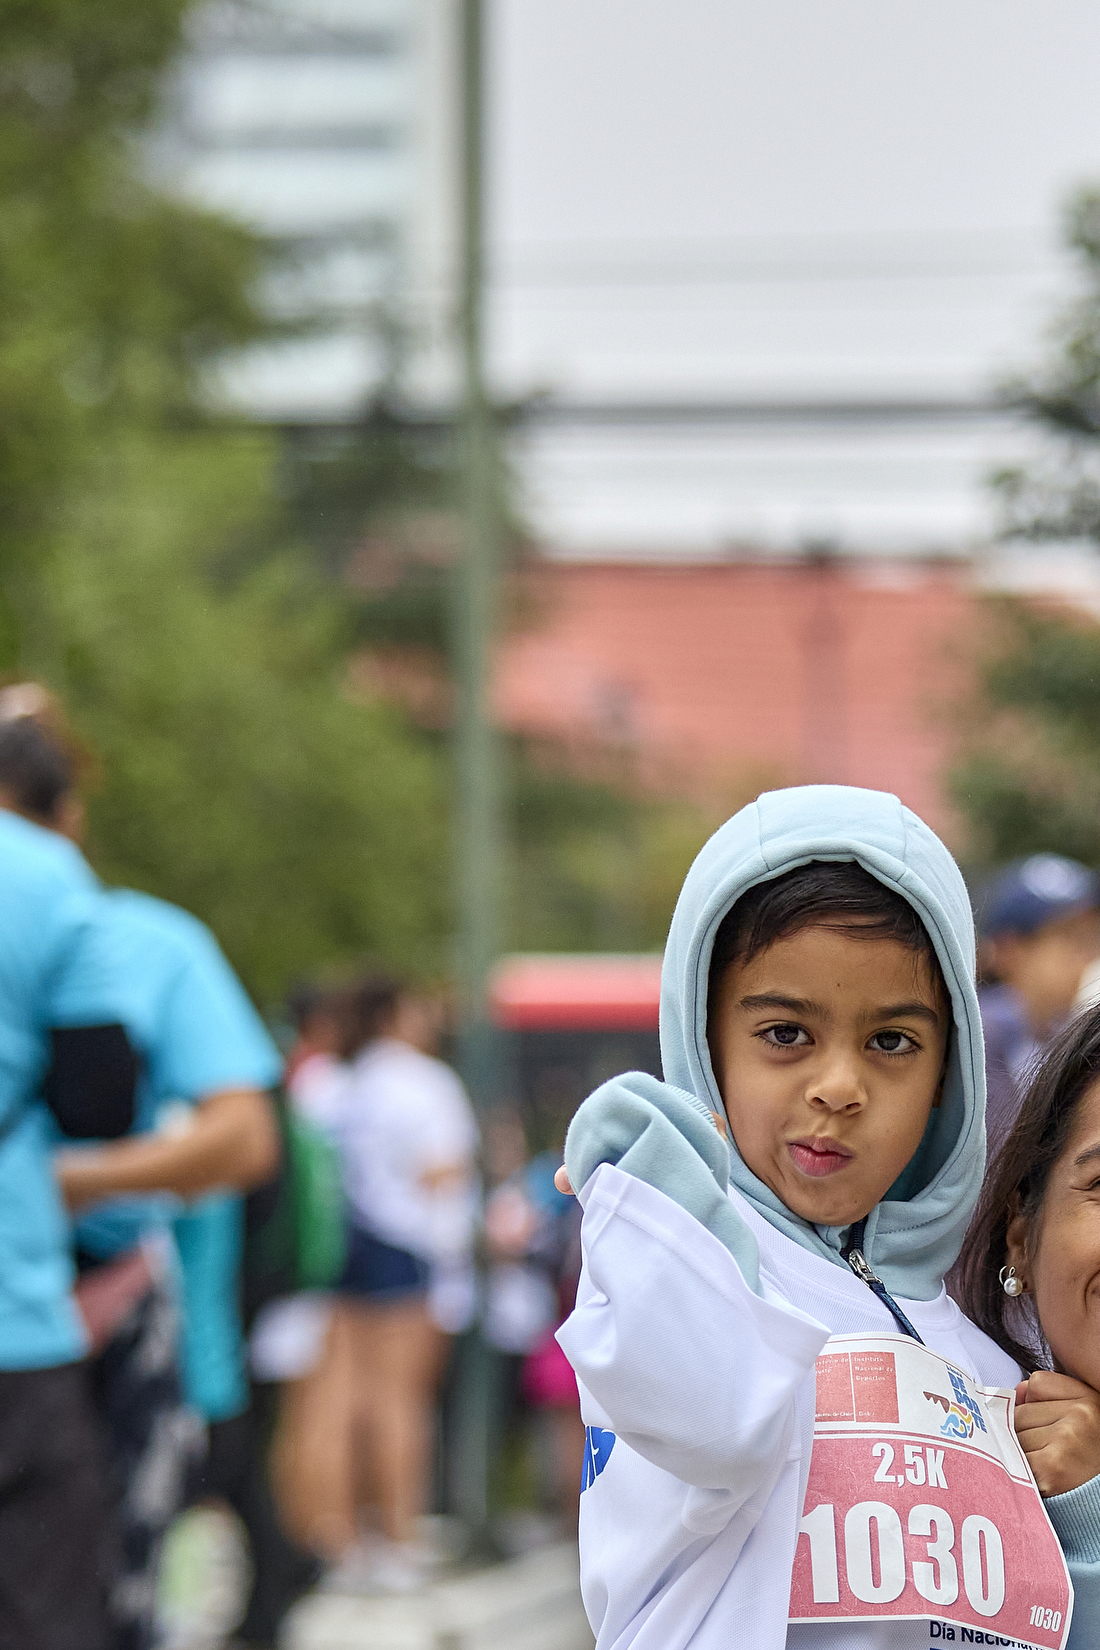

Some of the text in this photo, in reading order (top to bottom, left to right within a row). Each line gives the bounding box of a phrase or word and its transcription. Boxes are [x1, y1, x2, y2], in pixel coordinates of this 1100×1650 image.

[948, 1371, 968, 1395] DE
[971, 1411, 988, 1434] TE
[872, 1442, 949, 1490] 2,5K
[798, 1500, 1006, 1617] 1030
[930, 1620, 956, 1640] Día
[1029, 1604, 1062, 1633] 1030
